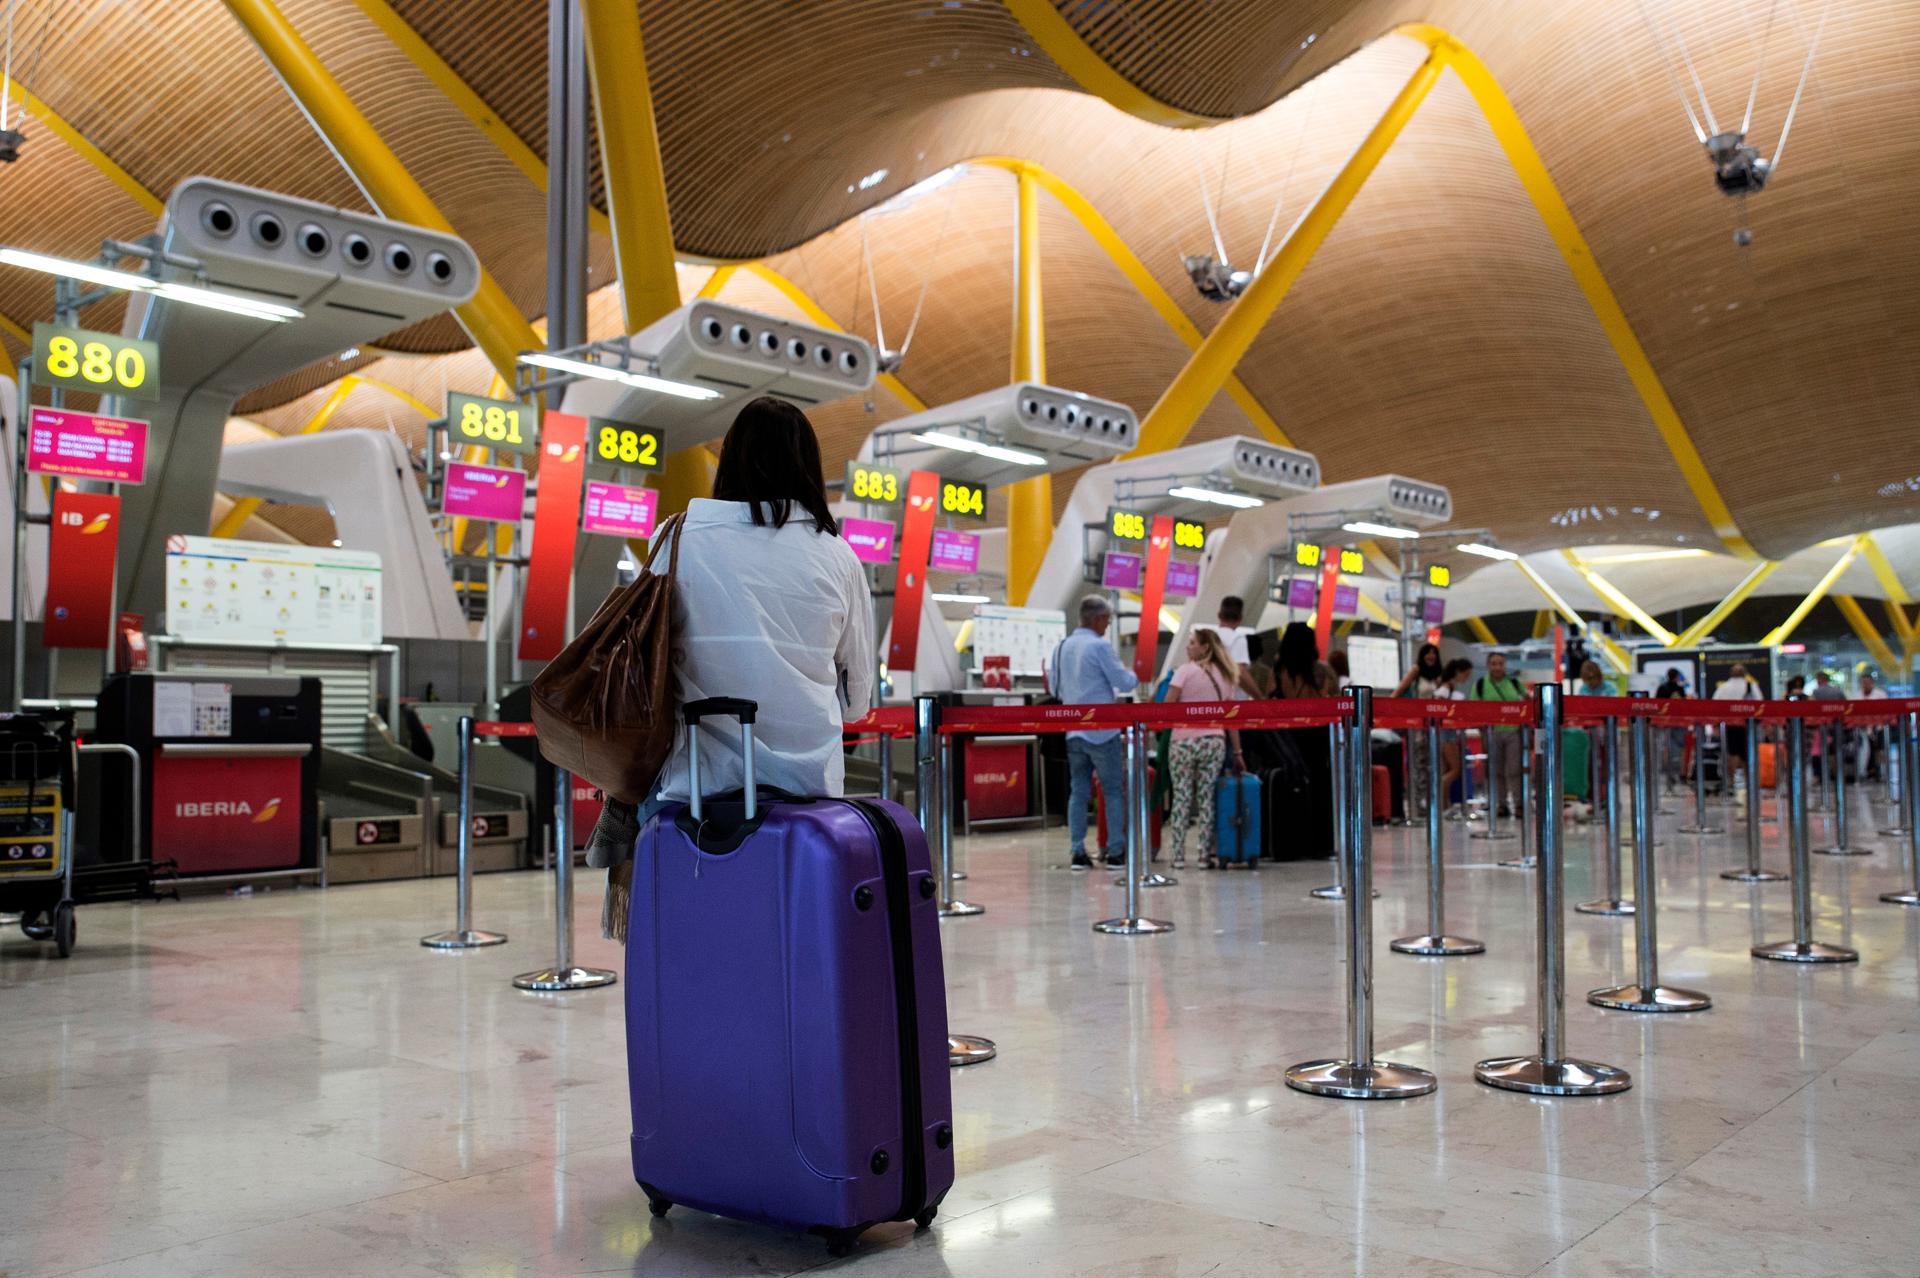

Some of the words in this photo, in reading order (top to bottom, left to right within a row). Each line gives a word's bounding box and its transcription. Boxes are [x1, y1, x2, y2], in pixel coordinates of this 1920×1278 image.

[47, 336, 145, 388] 880
[461, 402, 523, 444] 881
[598, 426, 658, 466] 882
[853, 469, 897, 501] 883
[943, 484, 984, 515] 884
[61, 512, 84, 526] IB
[1113, 512, 1145, 539] 885
[1045, 709, 1082, 718] IBERIA
[1186, 706, 1225, 715] IBERIA
[1426, 704, 1448, 713] IBERIA
[974, 773, 1006, 785] IBERIA
[176, 801, 252, 817] IBERIA
